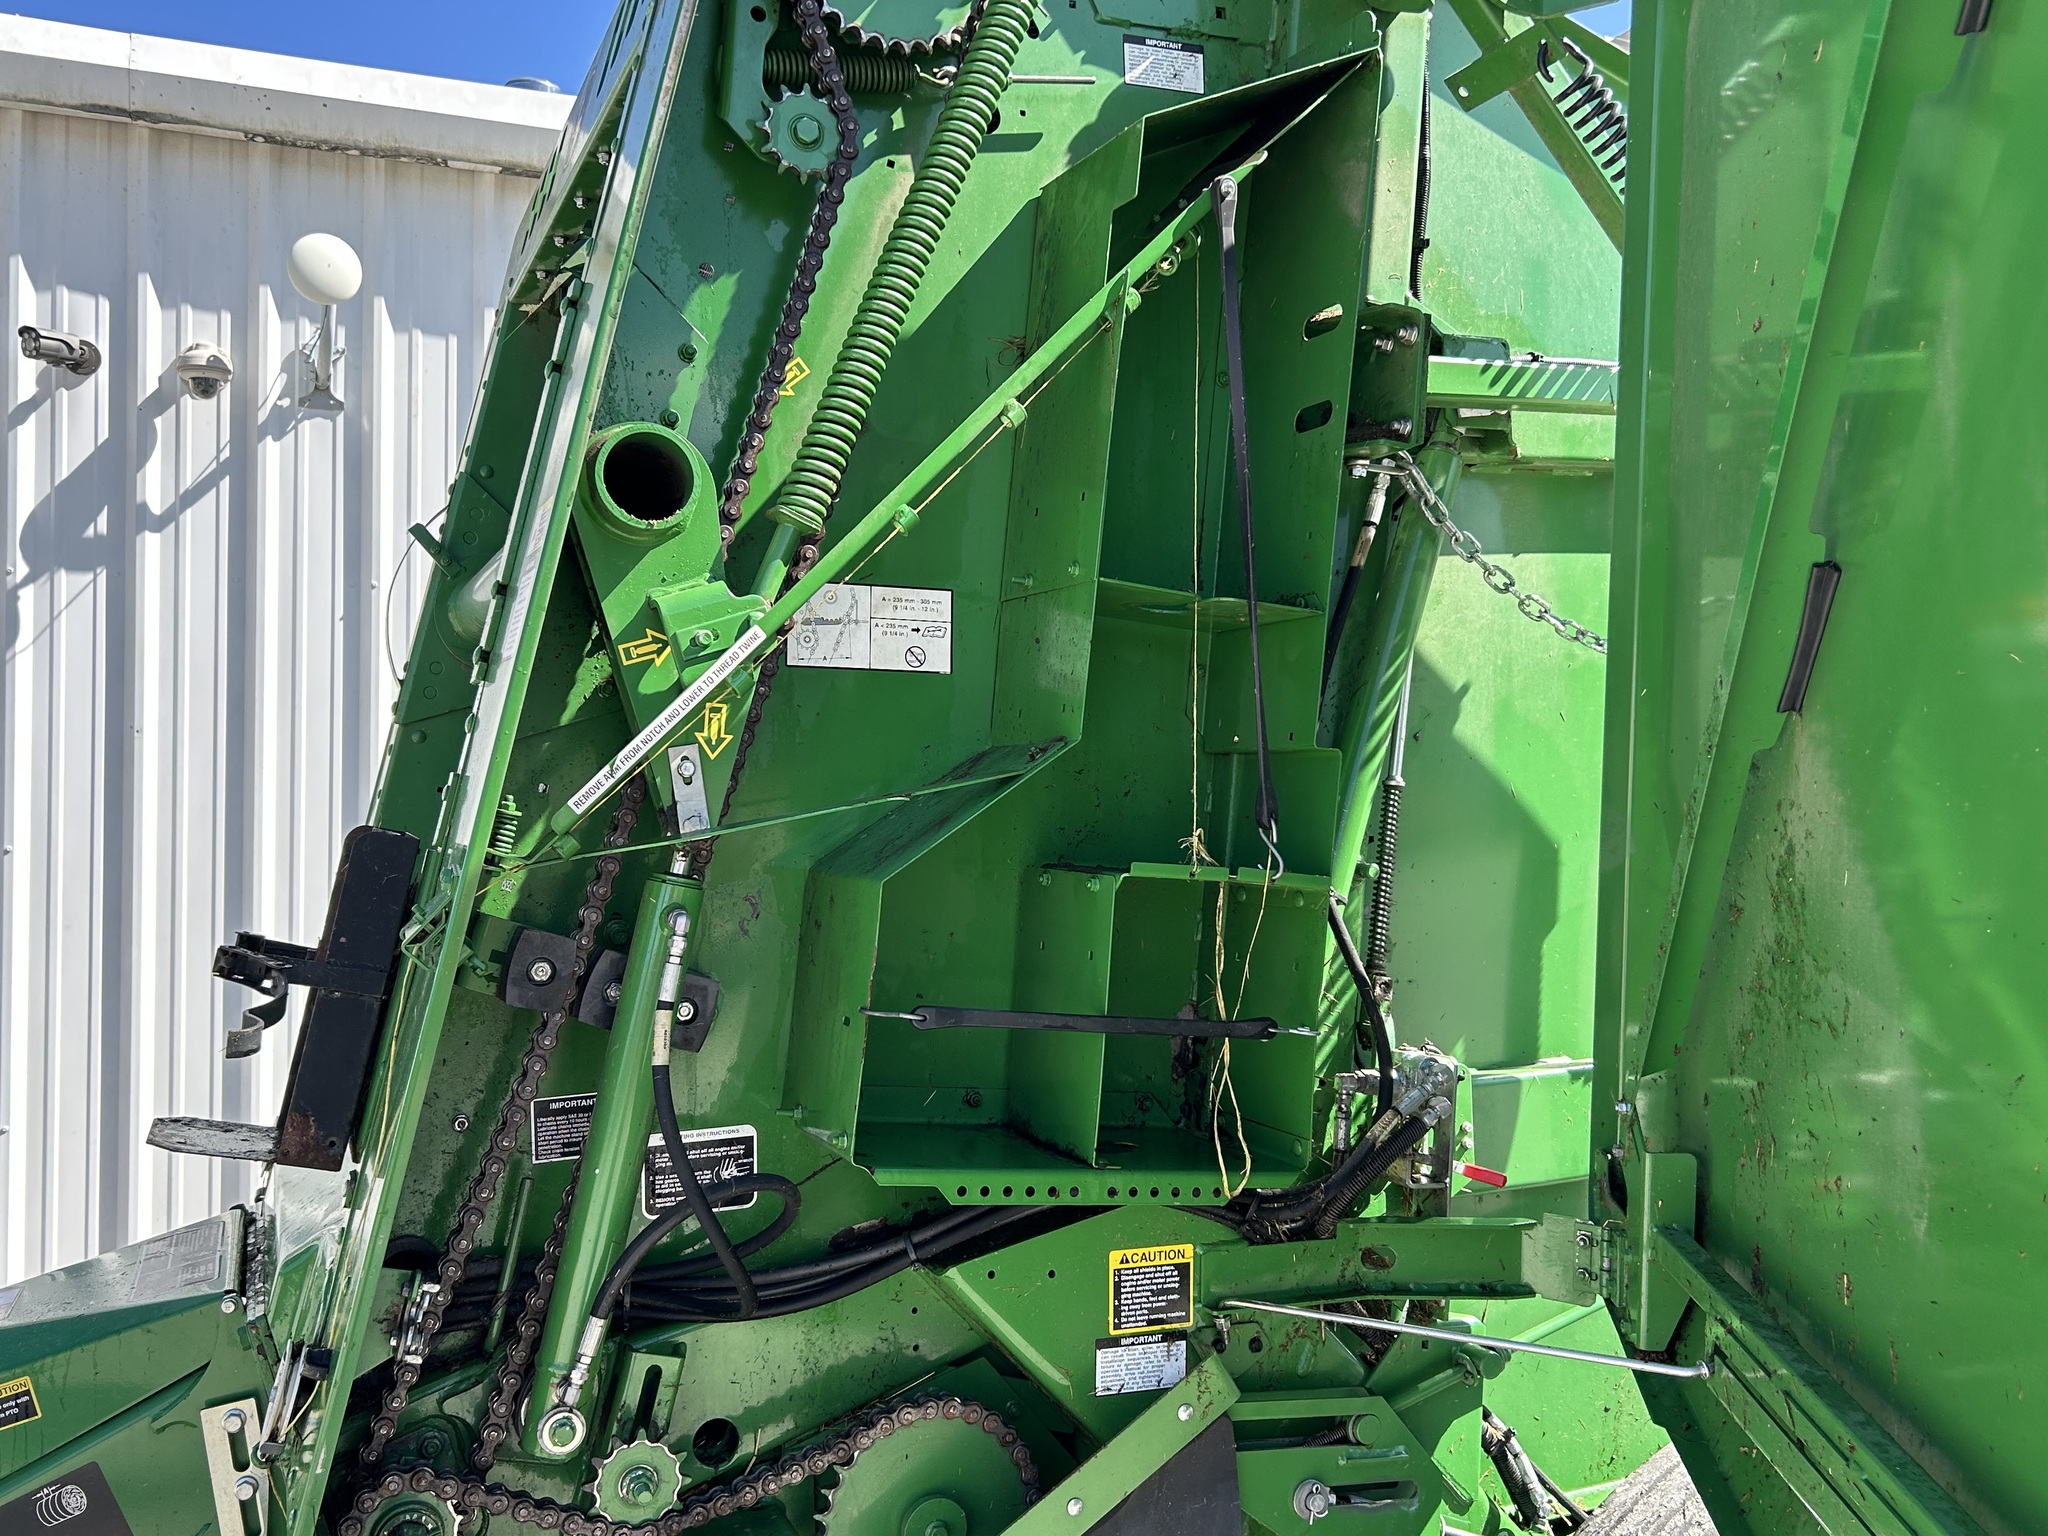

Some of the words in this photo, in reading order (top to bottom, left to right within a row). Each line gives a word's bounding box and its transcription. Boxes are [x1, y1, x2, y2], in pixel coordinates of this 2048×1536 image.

[1145, 39, 1182, 49] IMPORTANT
[573, 779, 605, 810] REMOVE
[605, 766, 621, 784] ARM
[620, 744, 642, 766] FROM
[640, 723, 664, 751] NOTCH
[665, 709, 681, 726] AND
[680, 686, 705, 713] LOWER
[704, 676, 714, 689] TO
[712, 650, 740, 679] THREAD
[737, 630, 761, 655] TWINE
[696, 1128, 740, 1138] INSTRUCTIONS
[1131, 1249, 1185, 1263] CAUTION
[1120, 1334, 1162, 1345] IMPORTANT
[6, 1408, 19, 1416] PTO
